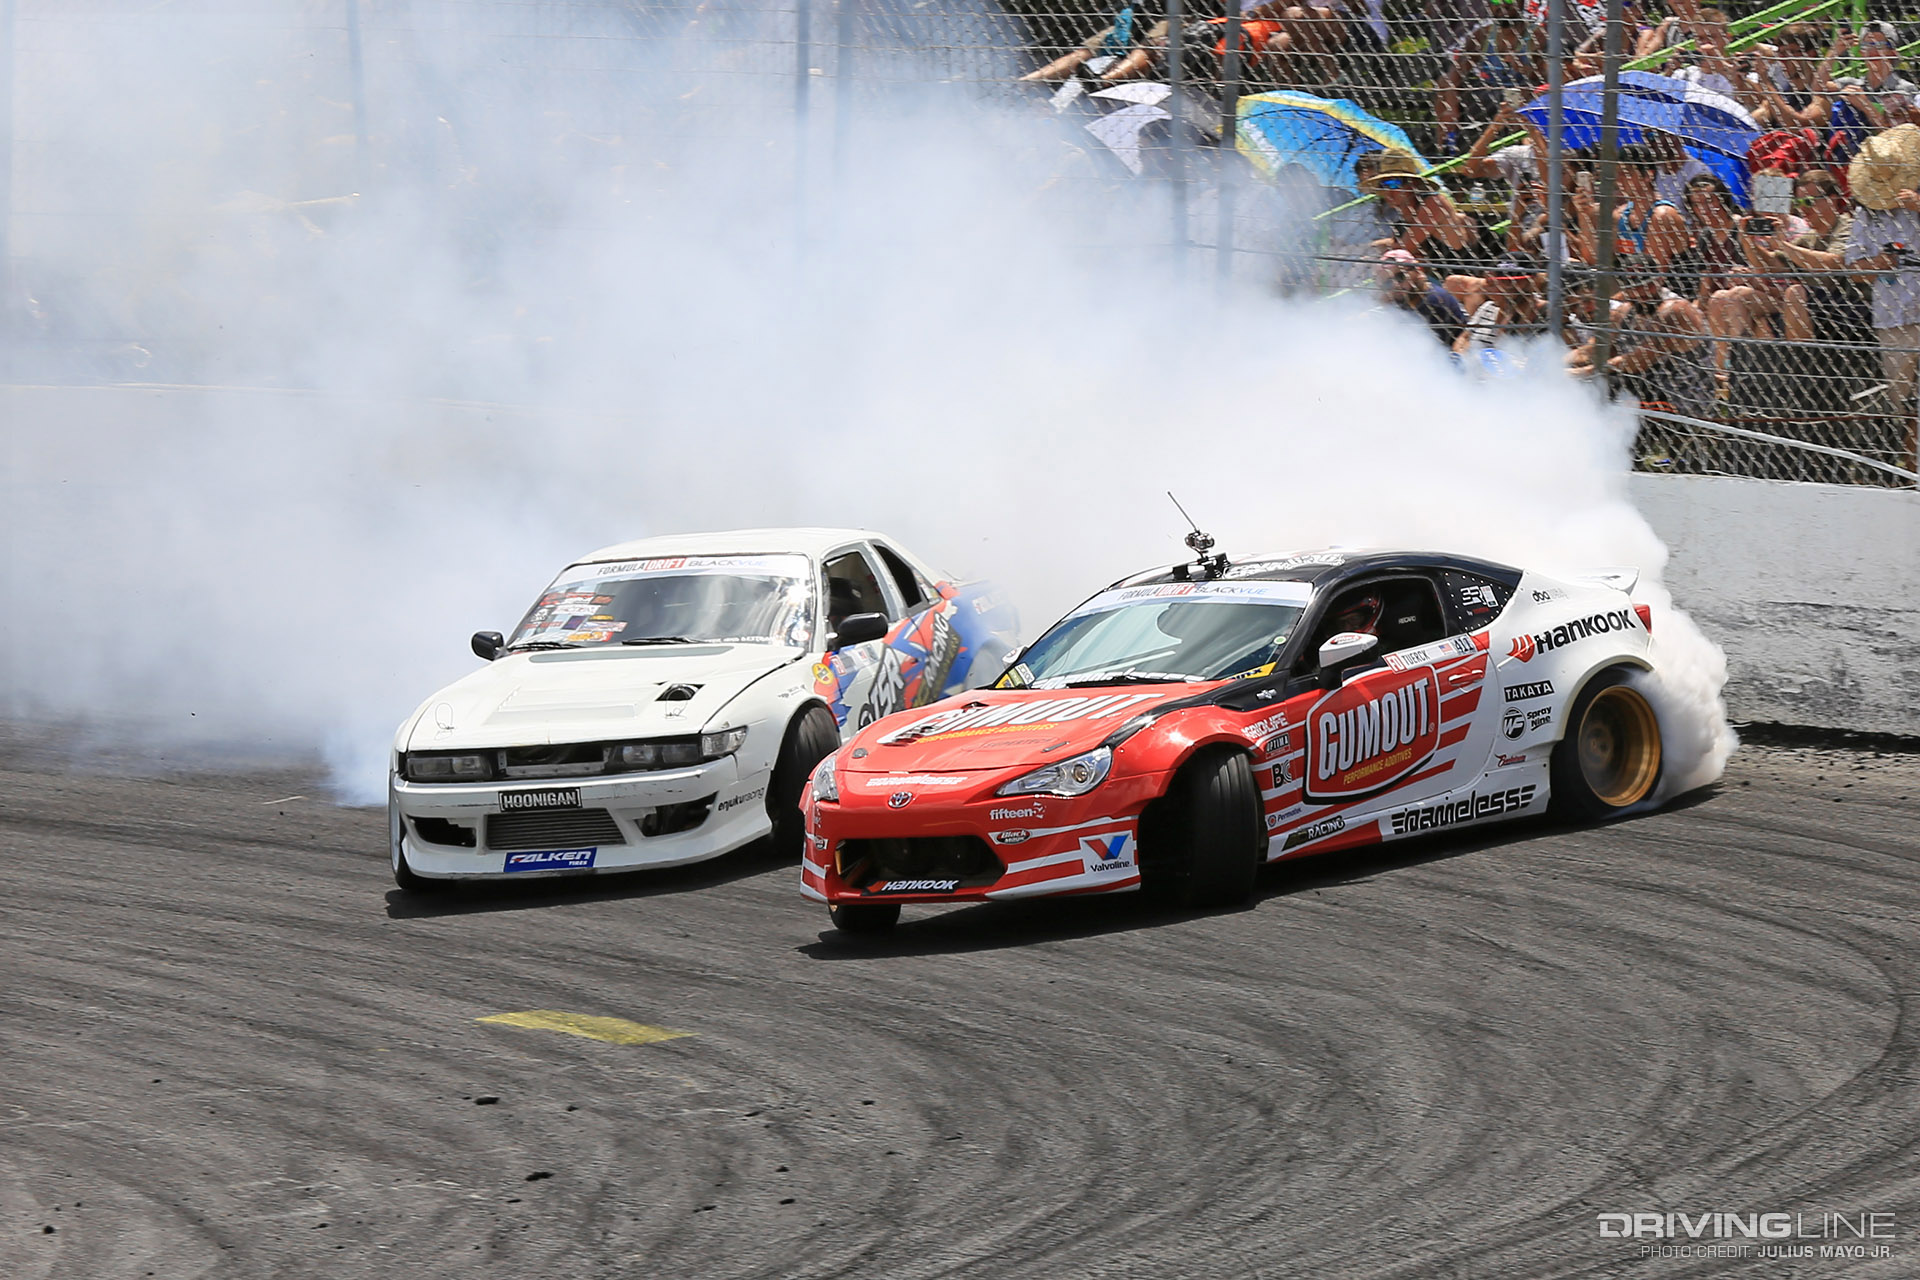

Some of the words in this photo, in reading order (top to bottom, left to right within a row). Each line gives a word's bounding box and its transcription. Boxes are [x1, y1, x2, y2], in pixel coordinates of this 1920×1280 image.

[597, 562, 645, 575] FORMULA
[645, 558, 687, 571] DRIFT
[1118, 587, 1160, 600] FORMULA
[1158, 584, 1195, 597] DRIFT
[1401, 650, 1431, 666] TUERCK
[1505, 682, 1553, 700] TAKATA
[1527, 706, 1552, 720] Spray
[1318, 677, 1431, 781] GUMOUT
[1531, 715, 1551, 728] Nine
[1343, 759, 1384, 785] PERFORMANCE
[1384, 747, 1413, 768] ADDITIVES
[1307, 817, 1345, 839] RACING
[508, 851, 592, 864] FALKEN
[1090, 860, 1131, 872] Valvoline
